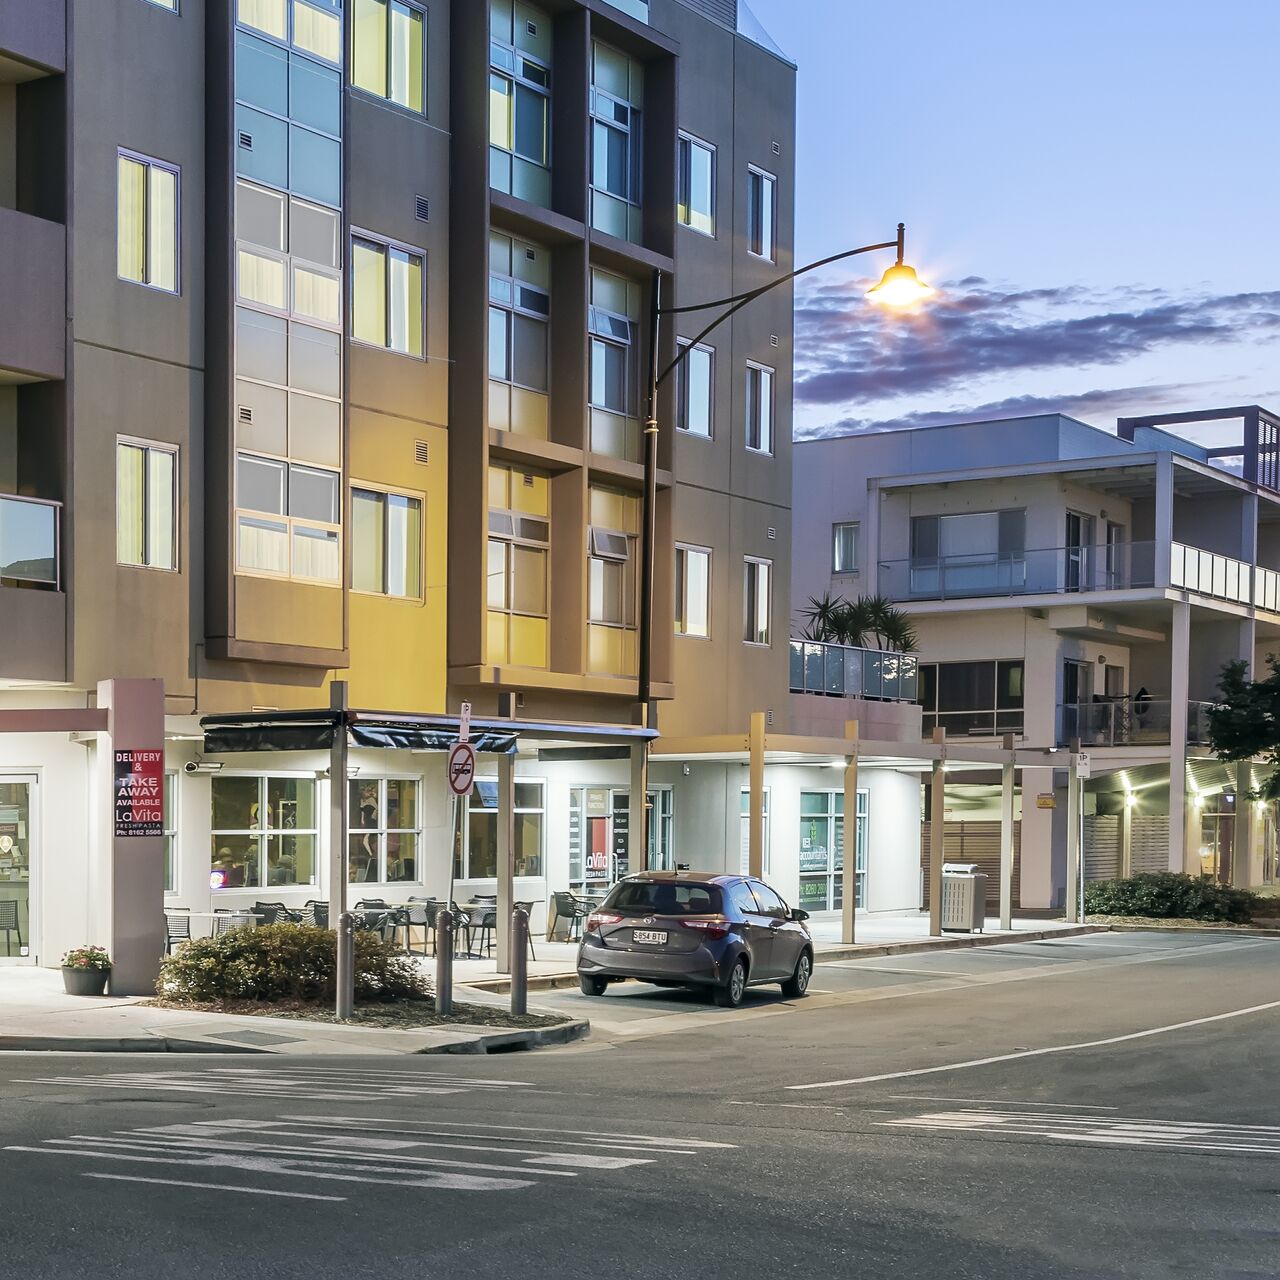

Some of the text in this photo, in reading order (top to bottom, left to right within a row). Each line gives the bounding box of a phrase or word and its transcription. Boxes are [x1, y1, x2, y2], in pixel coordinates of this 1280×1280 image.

[116, 753, 161, 762] DELIVERY
[134, 763, 142, 771] &
[119, 778, 157, 787] TAKE
[118, 787, 159, 796] AWAY
[115, 809, 161, 822] LaVita
